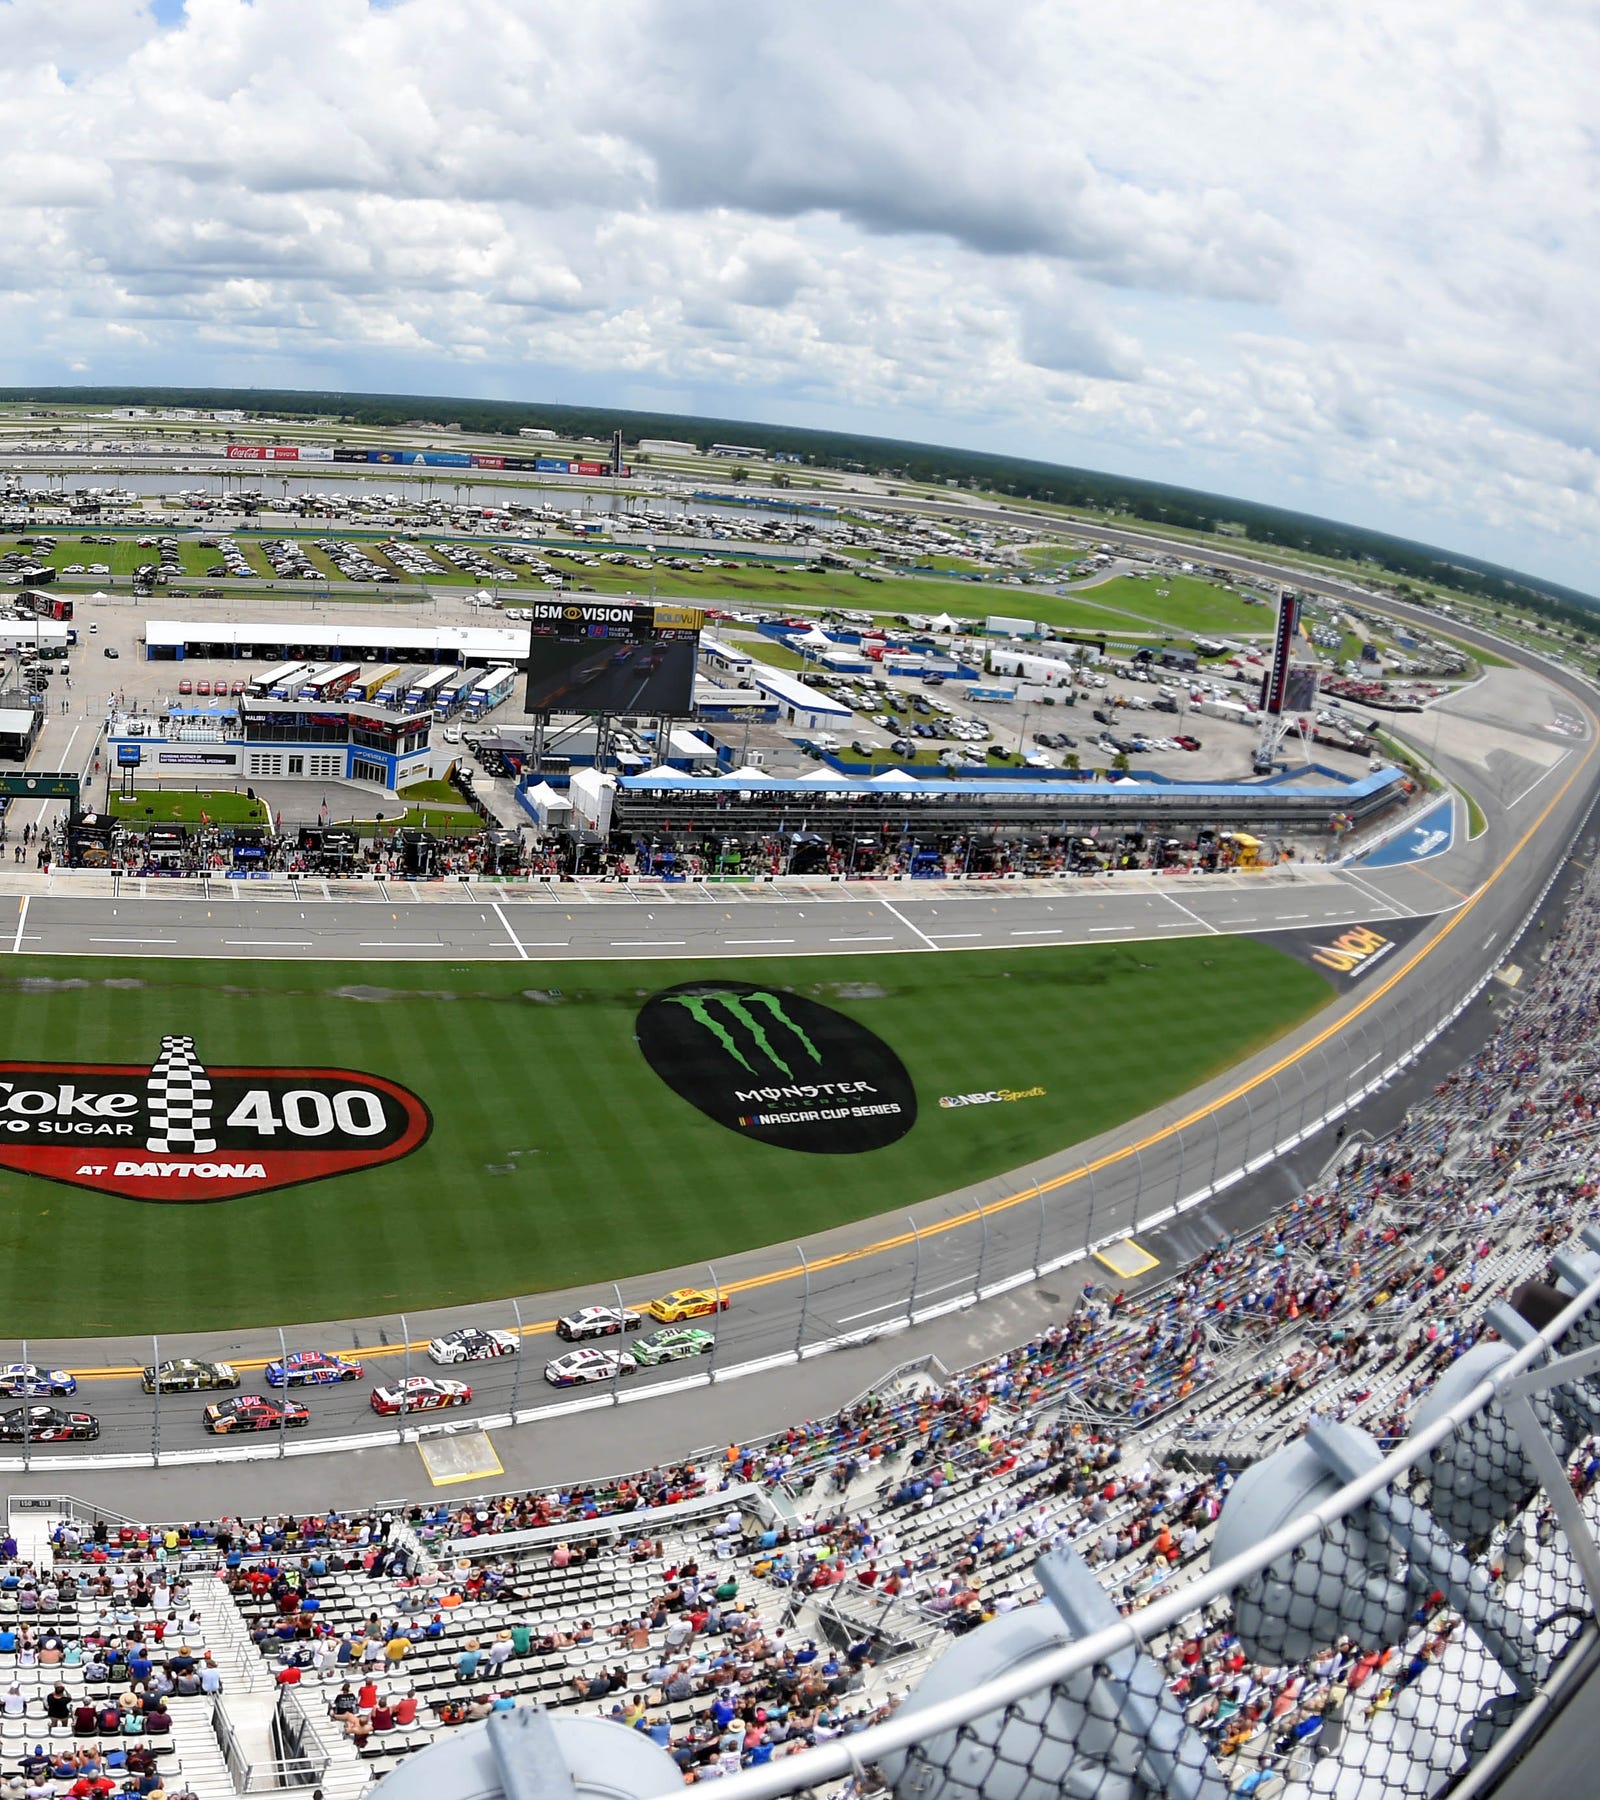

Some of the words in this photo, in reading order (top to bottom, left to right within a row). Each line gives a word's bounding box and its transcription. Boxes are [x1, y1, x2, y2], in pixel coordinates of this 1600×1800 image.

[535, 605, 562, 619] ISM
[582, 607, 633, 622] VISION
[661, 630, 675, 639] 12
[362, 751, 388, 763] CHEVROLET
[1312, 925, 1388, 972] UNOH
[766, 1096, 863, 1109] ENERGY
[227, 1090, 387, 1136] 400
[759, 1110, 823, 1125] NASCAR
[821, 1106, 851, 1120] CUP
[852, 1103, 901, 1118] SERIES
[38, 1122, 133, 1136] SUGAR
[75, 1166, 108, 1176] AT
[113, 1161, 267, 1178] DAYTONA
[316, 1371, 329, 1381] 19
[596, 1368, 608, 1377] 11
[192, 1377, 200, 1389] 1
[421, 1396, 440, 1408] 12
[40, 1429, 55, 1439] 6
